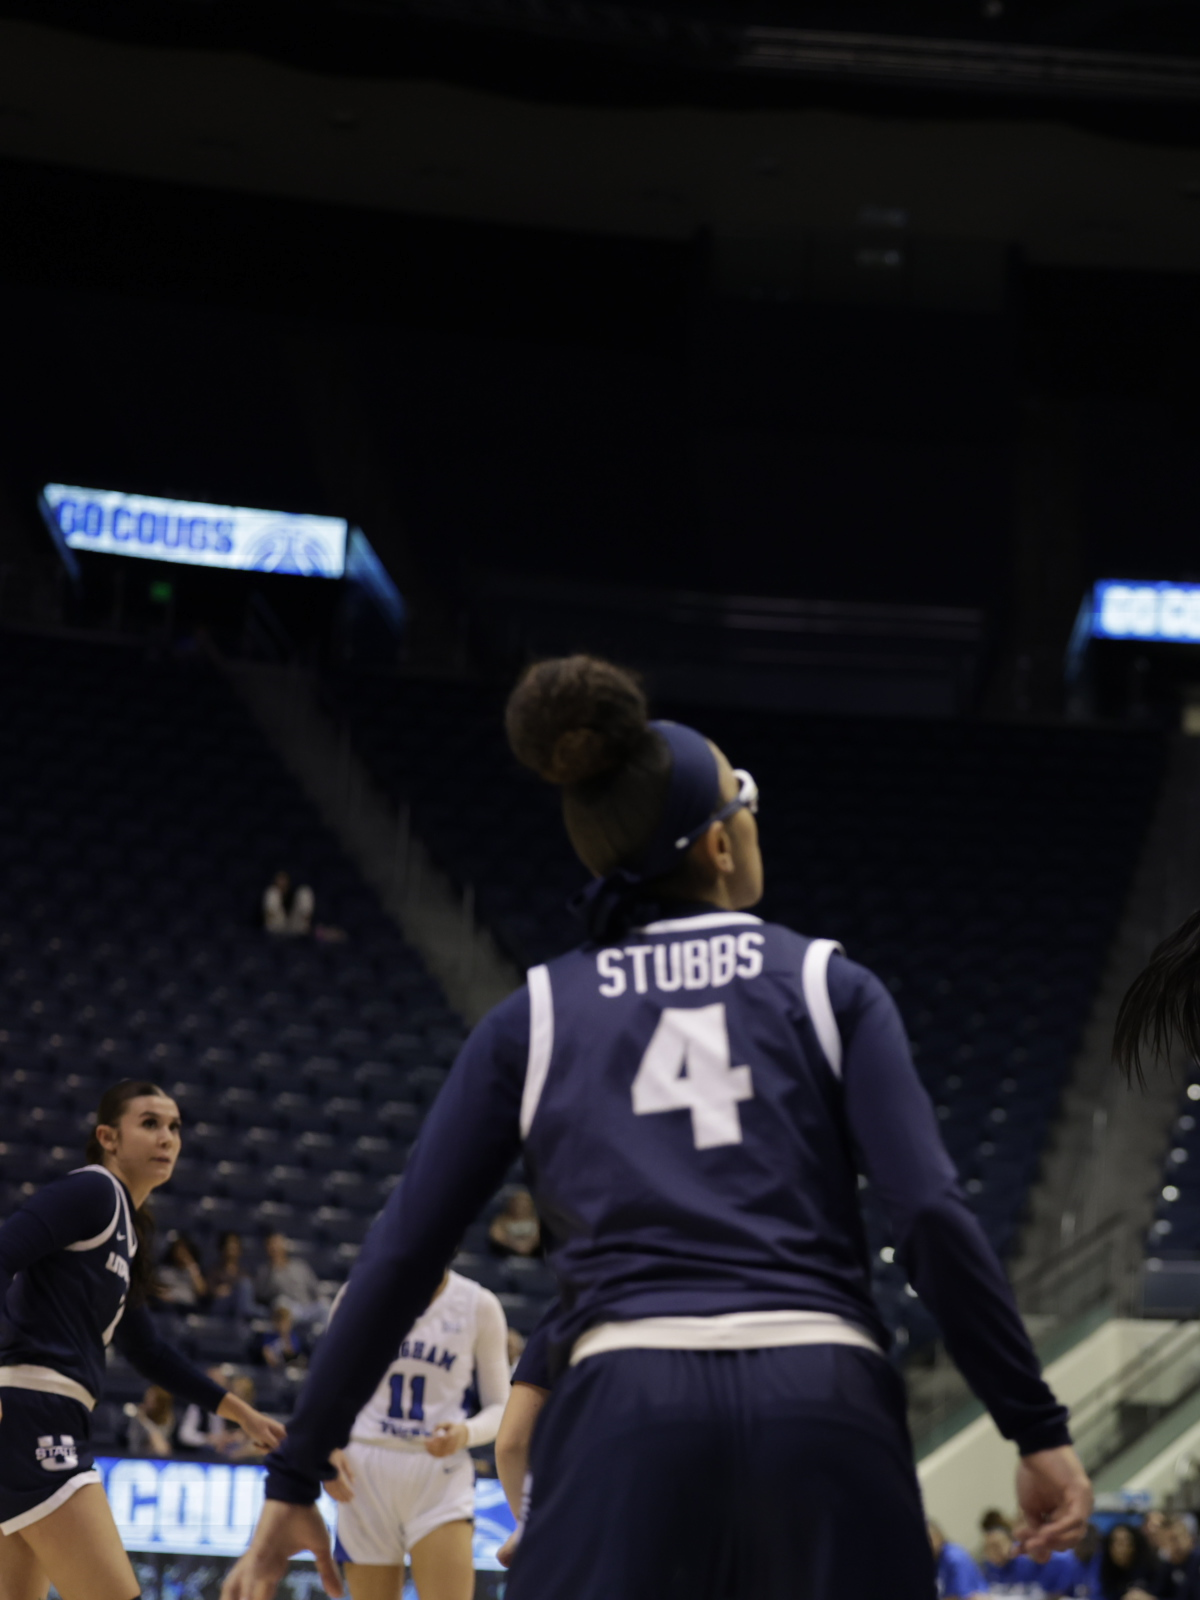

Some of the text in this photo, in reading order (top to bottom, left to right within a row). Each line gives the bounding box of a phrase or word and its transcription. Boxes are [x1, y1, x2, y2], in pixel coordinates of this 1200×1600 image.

[113, 508, 234, 554] COUGS
[597, 931, 765, 997] STUBBS
[631, 1002, 754, 1151] 4
[400, 1340, 457, 1372] GHAM
[388, 1373, 425, 1421] 11
[107, 1458, 262, 1547] COU
